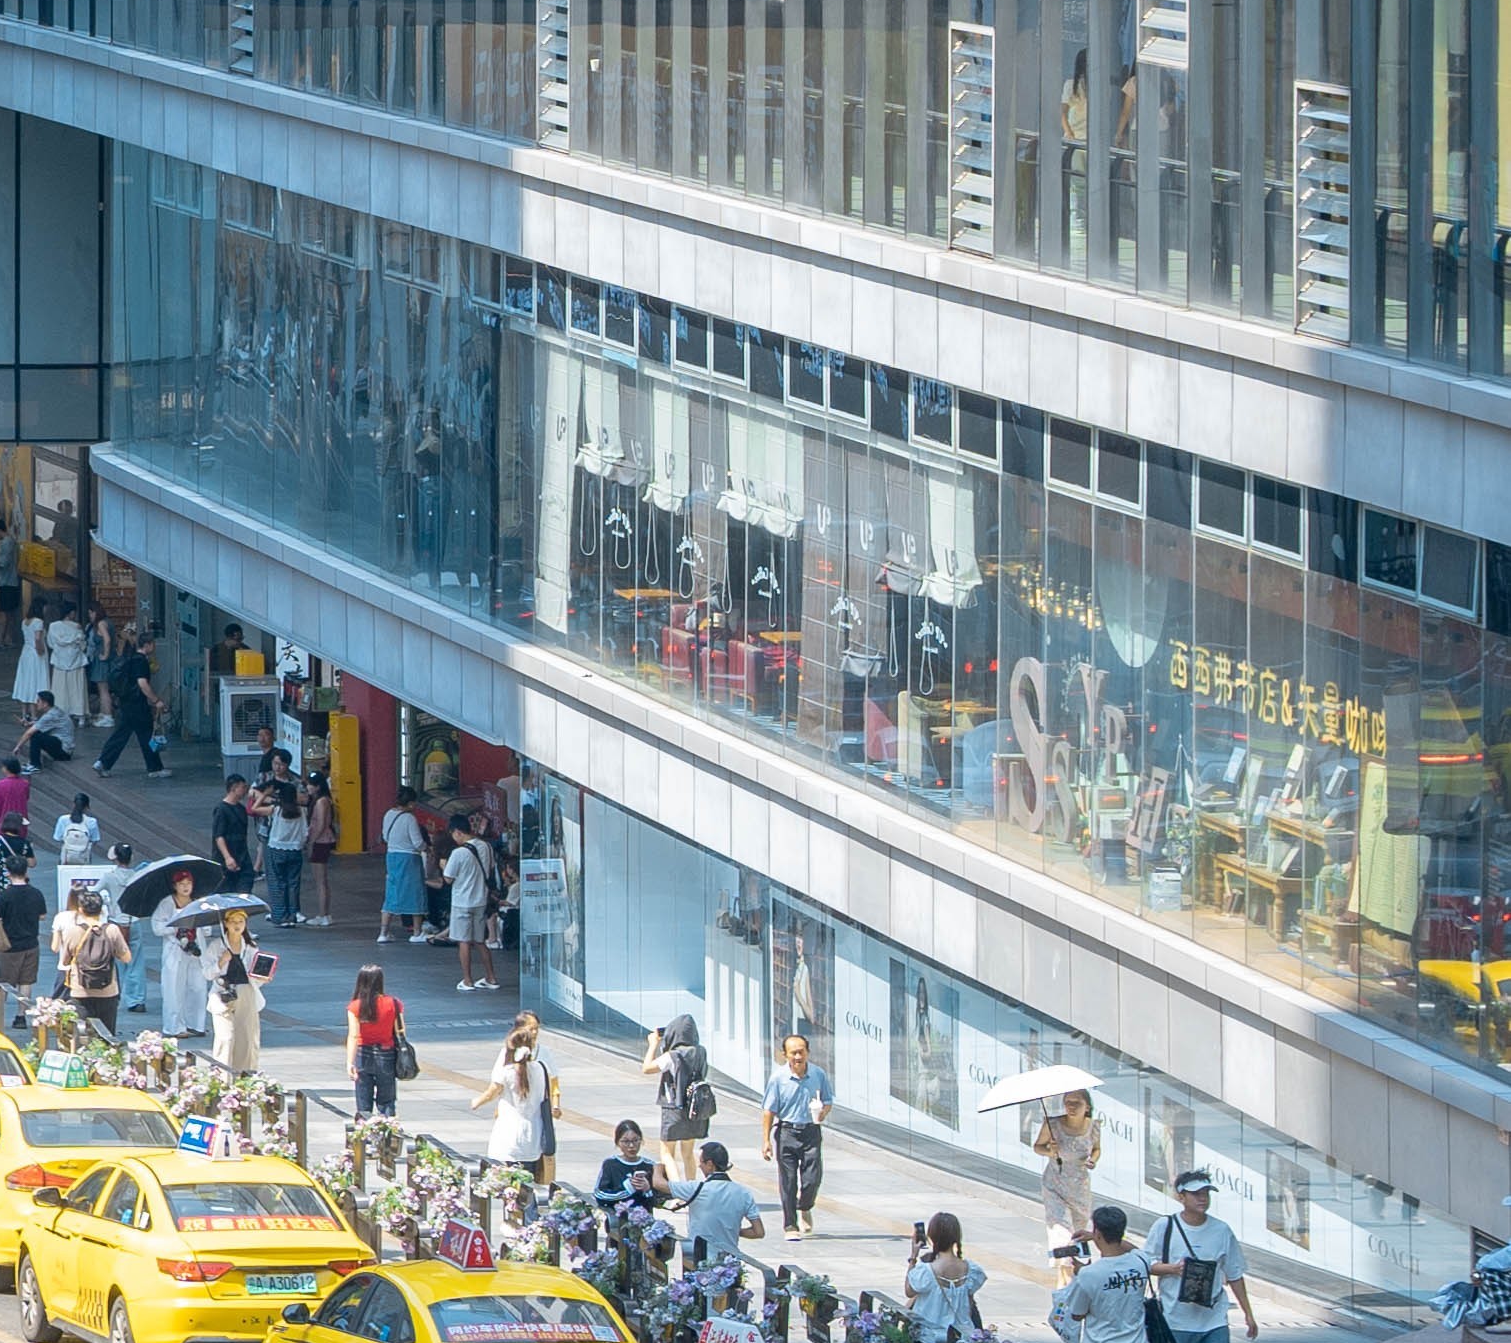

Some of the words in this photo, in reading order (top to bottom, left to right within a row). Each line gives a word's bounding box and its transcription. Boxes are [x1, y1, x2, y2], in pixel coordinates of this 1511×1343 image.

[845, 1010, 883, 1044] COACH
[1368, 1233, 1421, 1276] COACH
[268, 1274, 316, 1291] A30612
